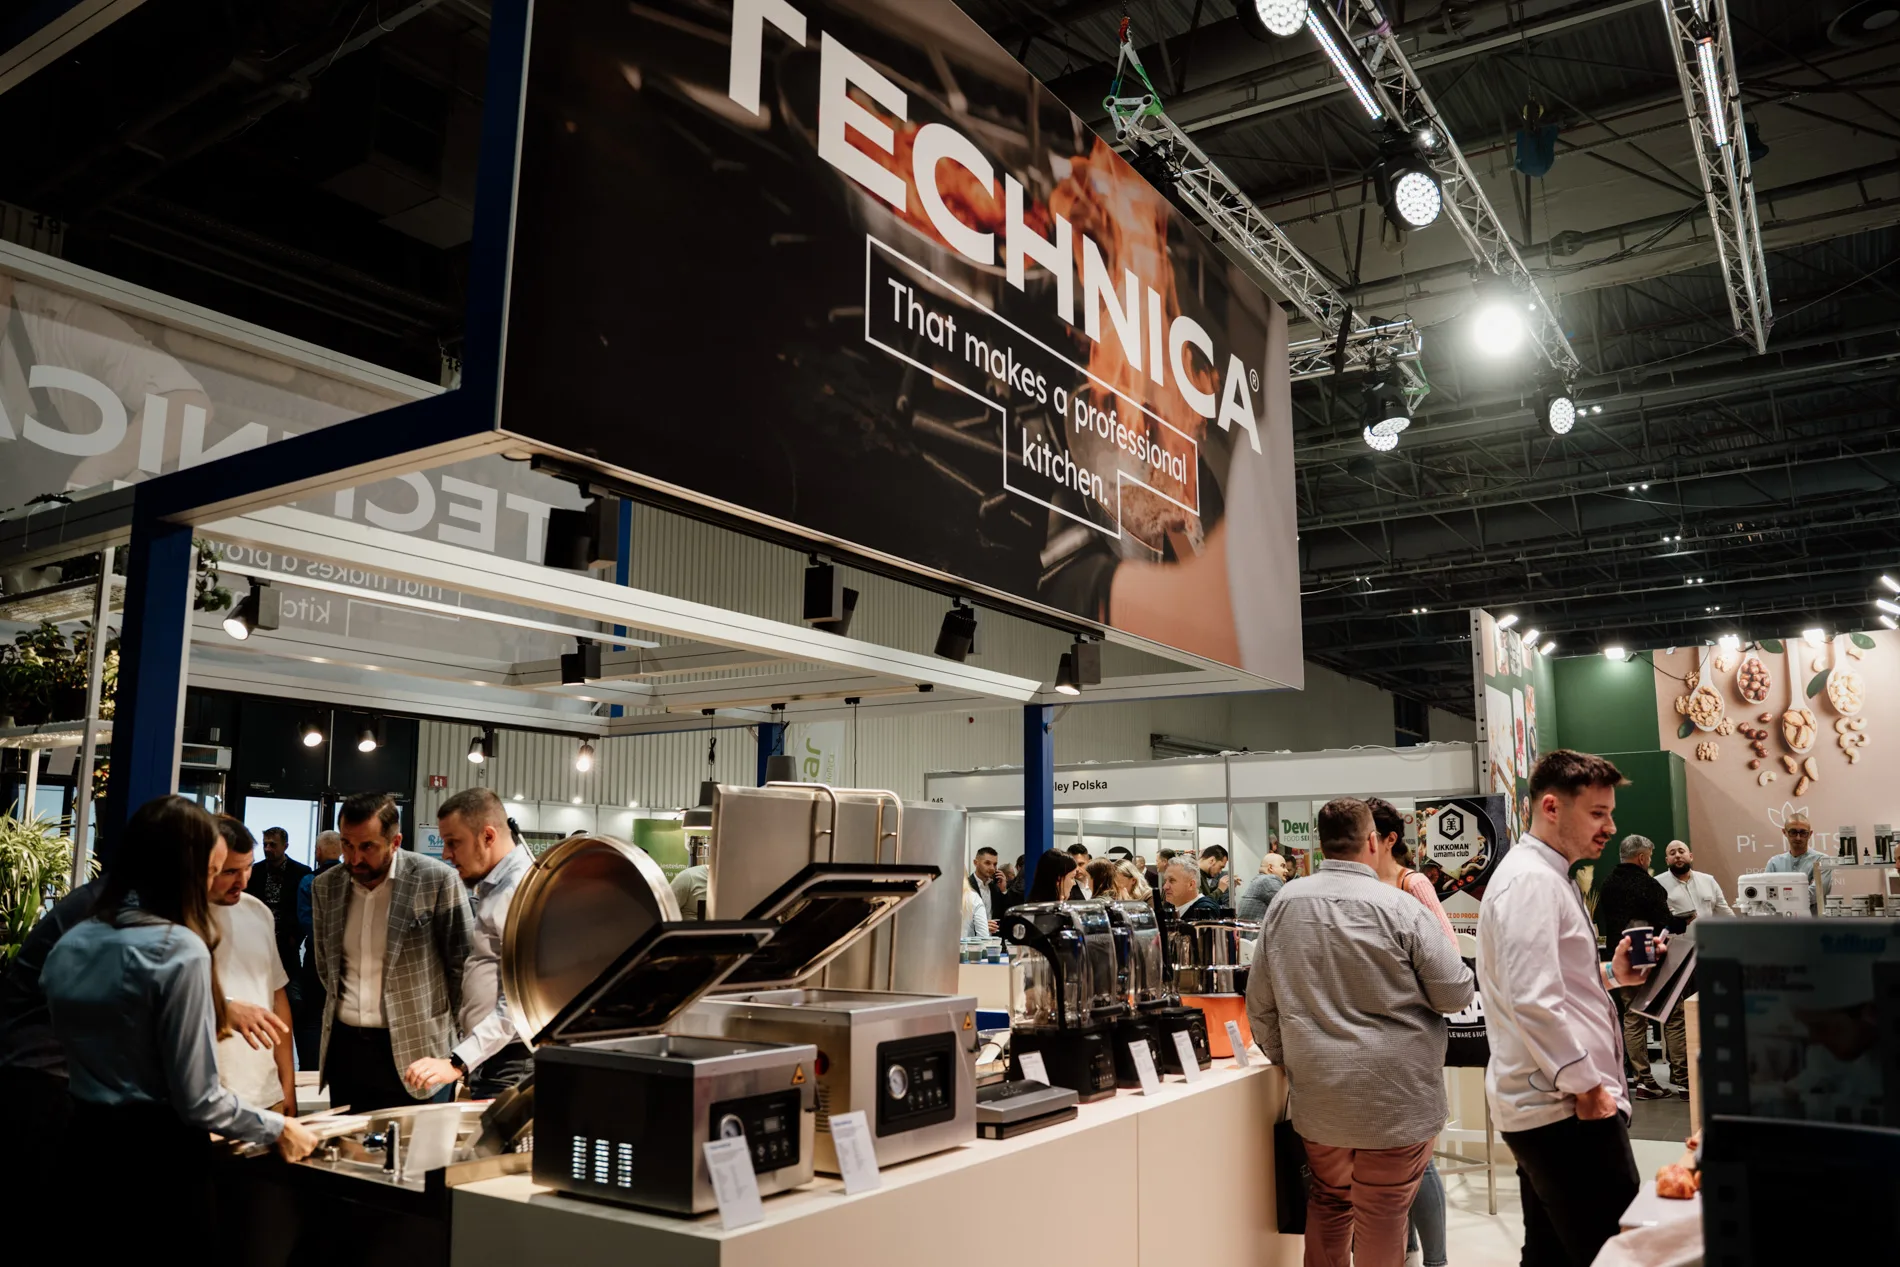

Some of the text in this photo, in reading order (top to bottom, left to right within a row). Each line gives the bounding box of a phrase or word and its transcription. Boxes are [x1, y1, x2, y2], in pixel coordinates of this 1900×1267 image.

[888, 277, 1187, 485] That makes a professional
[1022, 428, 1109, 505] kitchen.
[1053, 779, 1108, 794] ley Polska
[1433, 843, 1470, 851] KIKKOMAN
[1736, 834, 1756, 853] Pi
